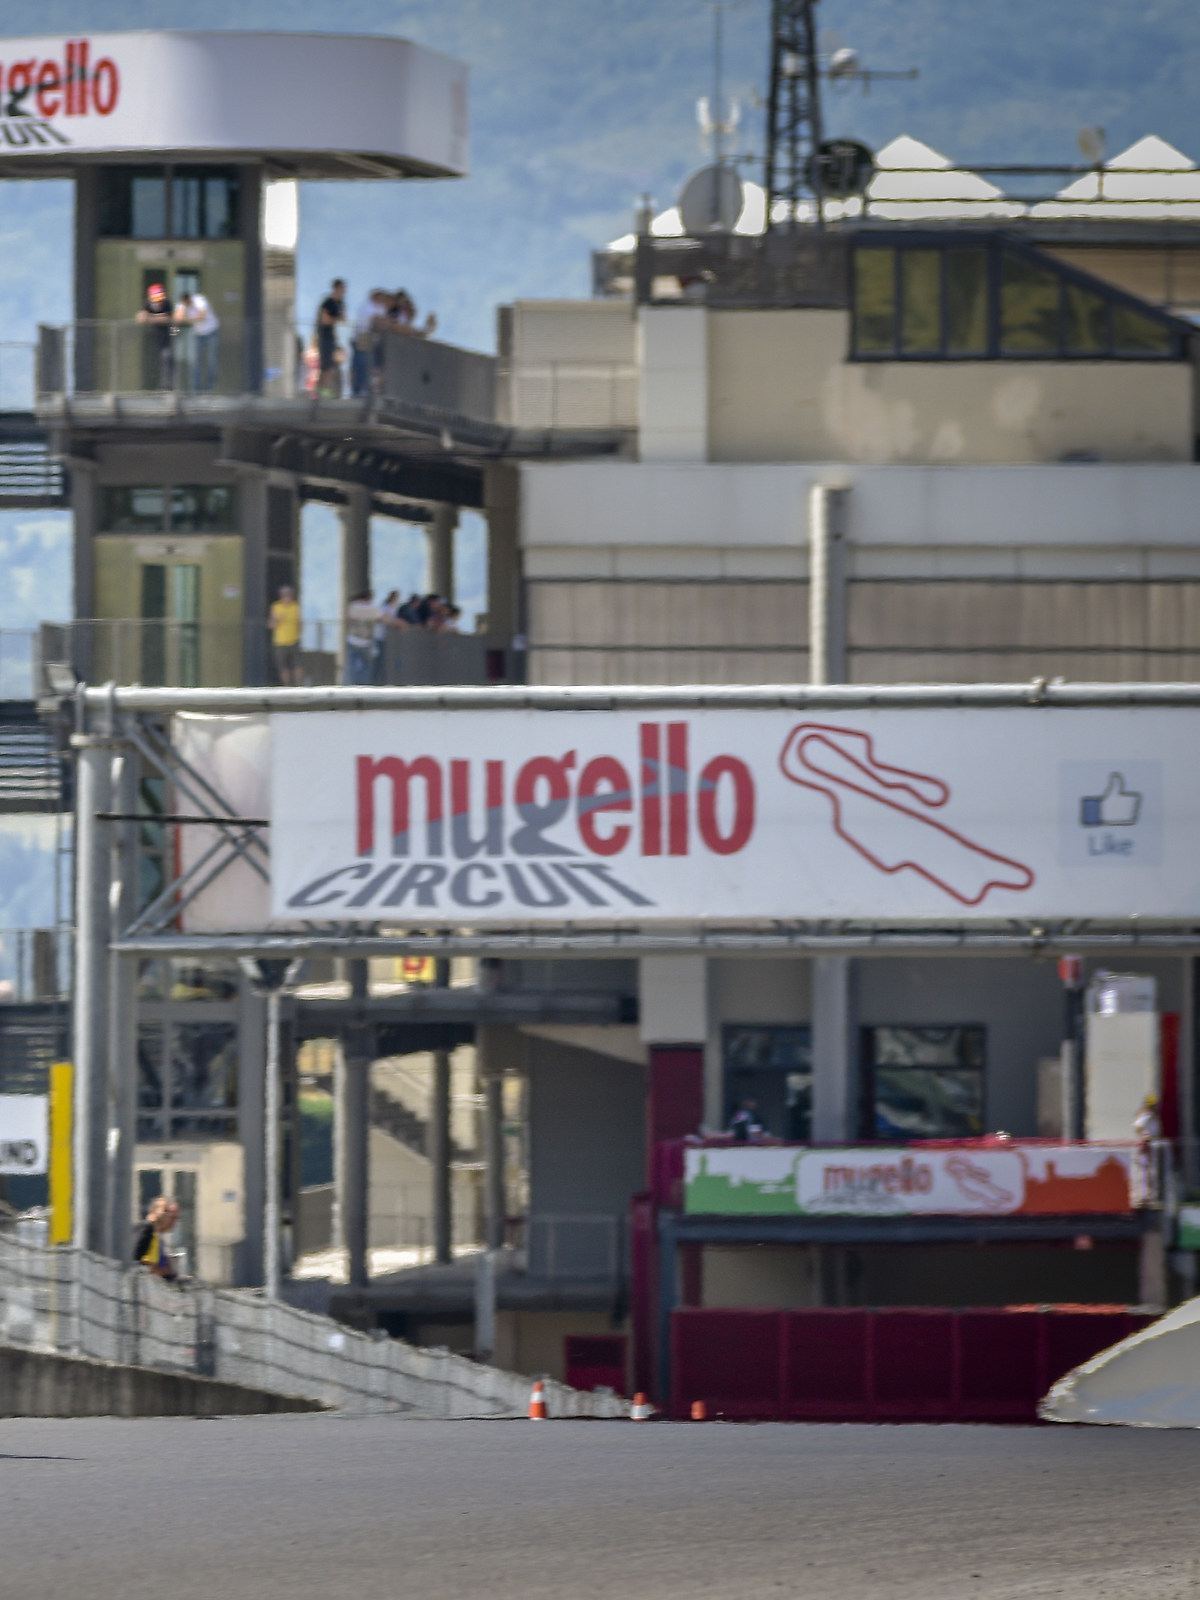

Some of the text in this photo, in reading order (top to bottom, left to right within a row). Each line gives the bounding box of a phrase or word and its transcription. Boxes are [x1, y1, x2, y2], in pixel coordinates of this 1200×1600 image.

[356, 721, 755, 859] mugello
[1088, 833, 1134, 856] Like
[286, 862, 657, 907] CIRCUIT
